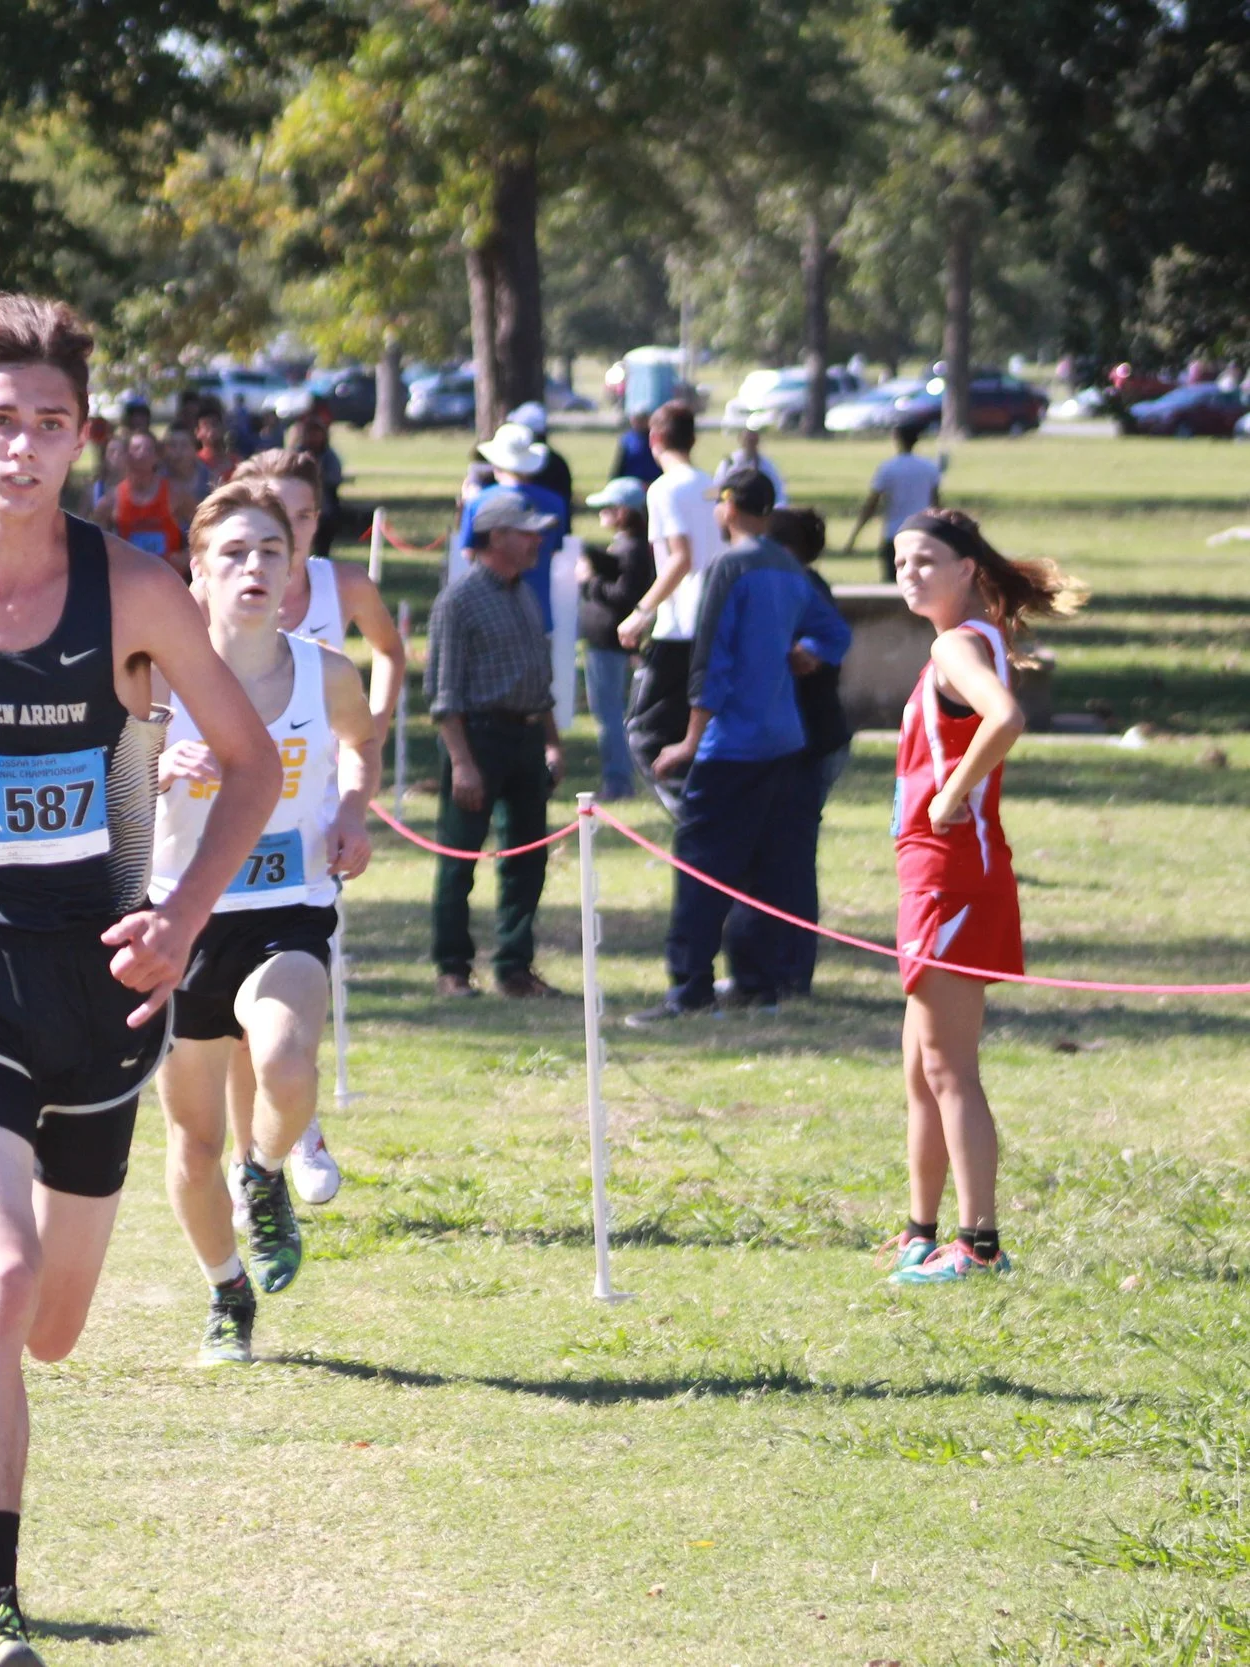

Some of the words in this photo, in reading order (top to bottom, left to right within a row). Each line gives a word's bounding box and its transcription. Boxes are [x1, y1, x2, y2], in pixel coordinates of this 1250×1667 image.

[19, 702, 87, 725] ARROW
[19, 764, 87, 778] CHAMPIONSHIP
[4, 779, 95, 834] 587
